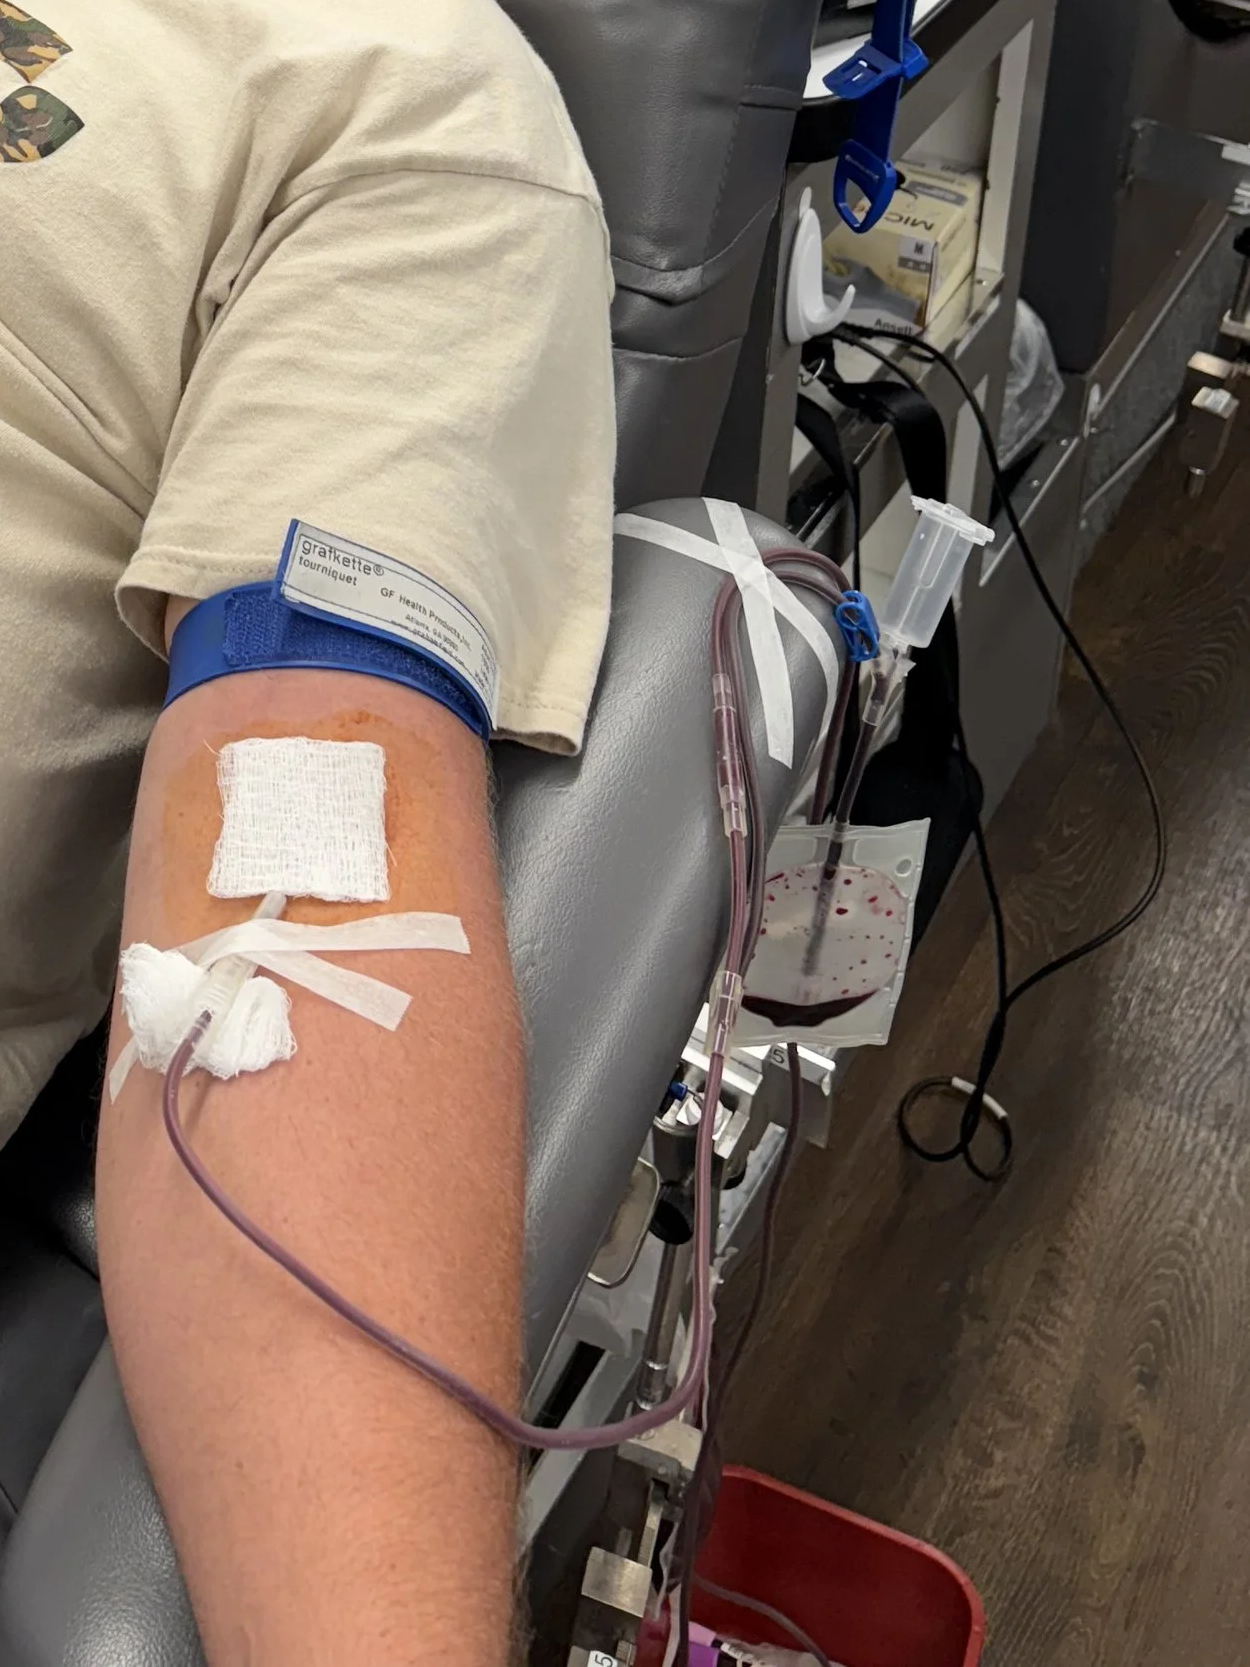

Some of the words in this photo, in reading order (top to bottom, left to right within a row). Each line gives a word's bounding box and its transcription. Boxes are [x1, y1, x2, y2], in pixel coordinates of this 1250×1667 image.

[299, 555, 357, 586] tourniquet
[380, 587, 395, 599] GF
[398, 595, 428, 615] Health
[772, 1049, 786, 1065] 5
